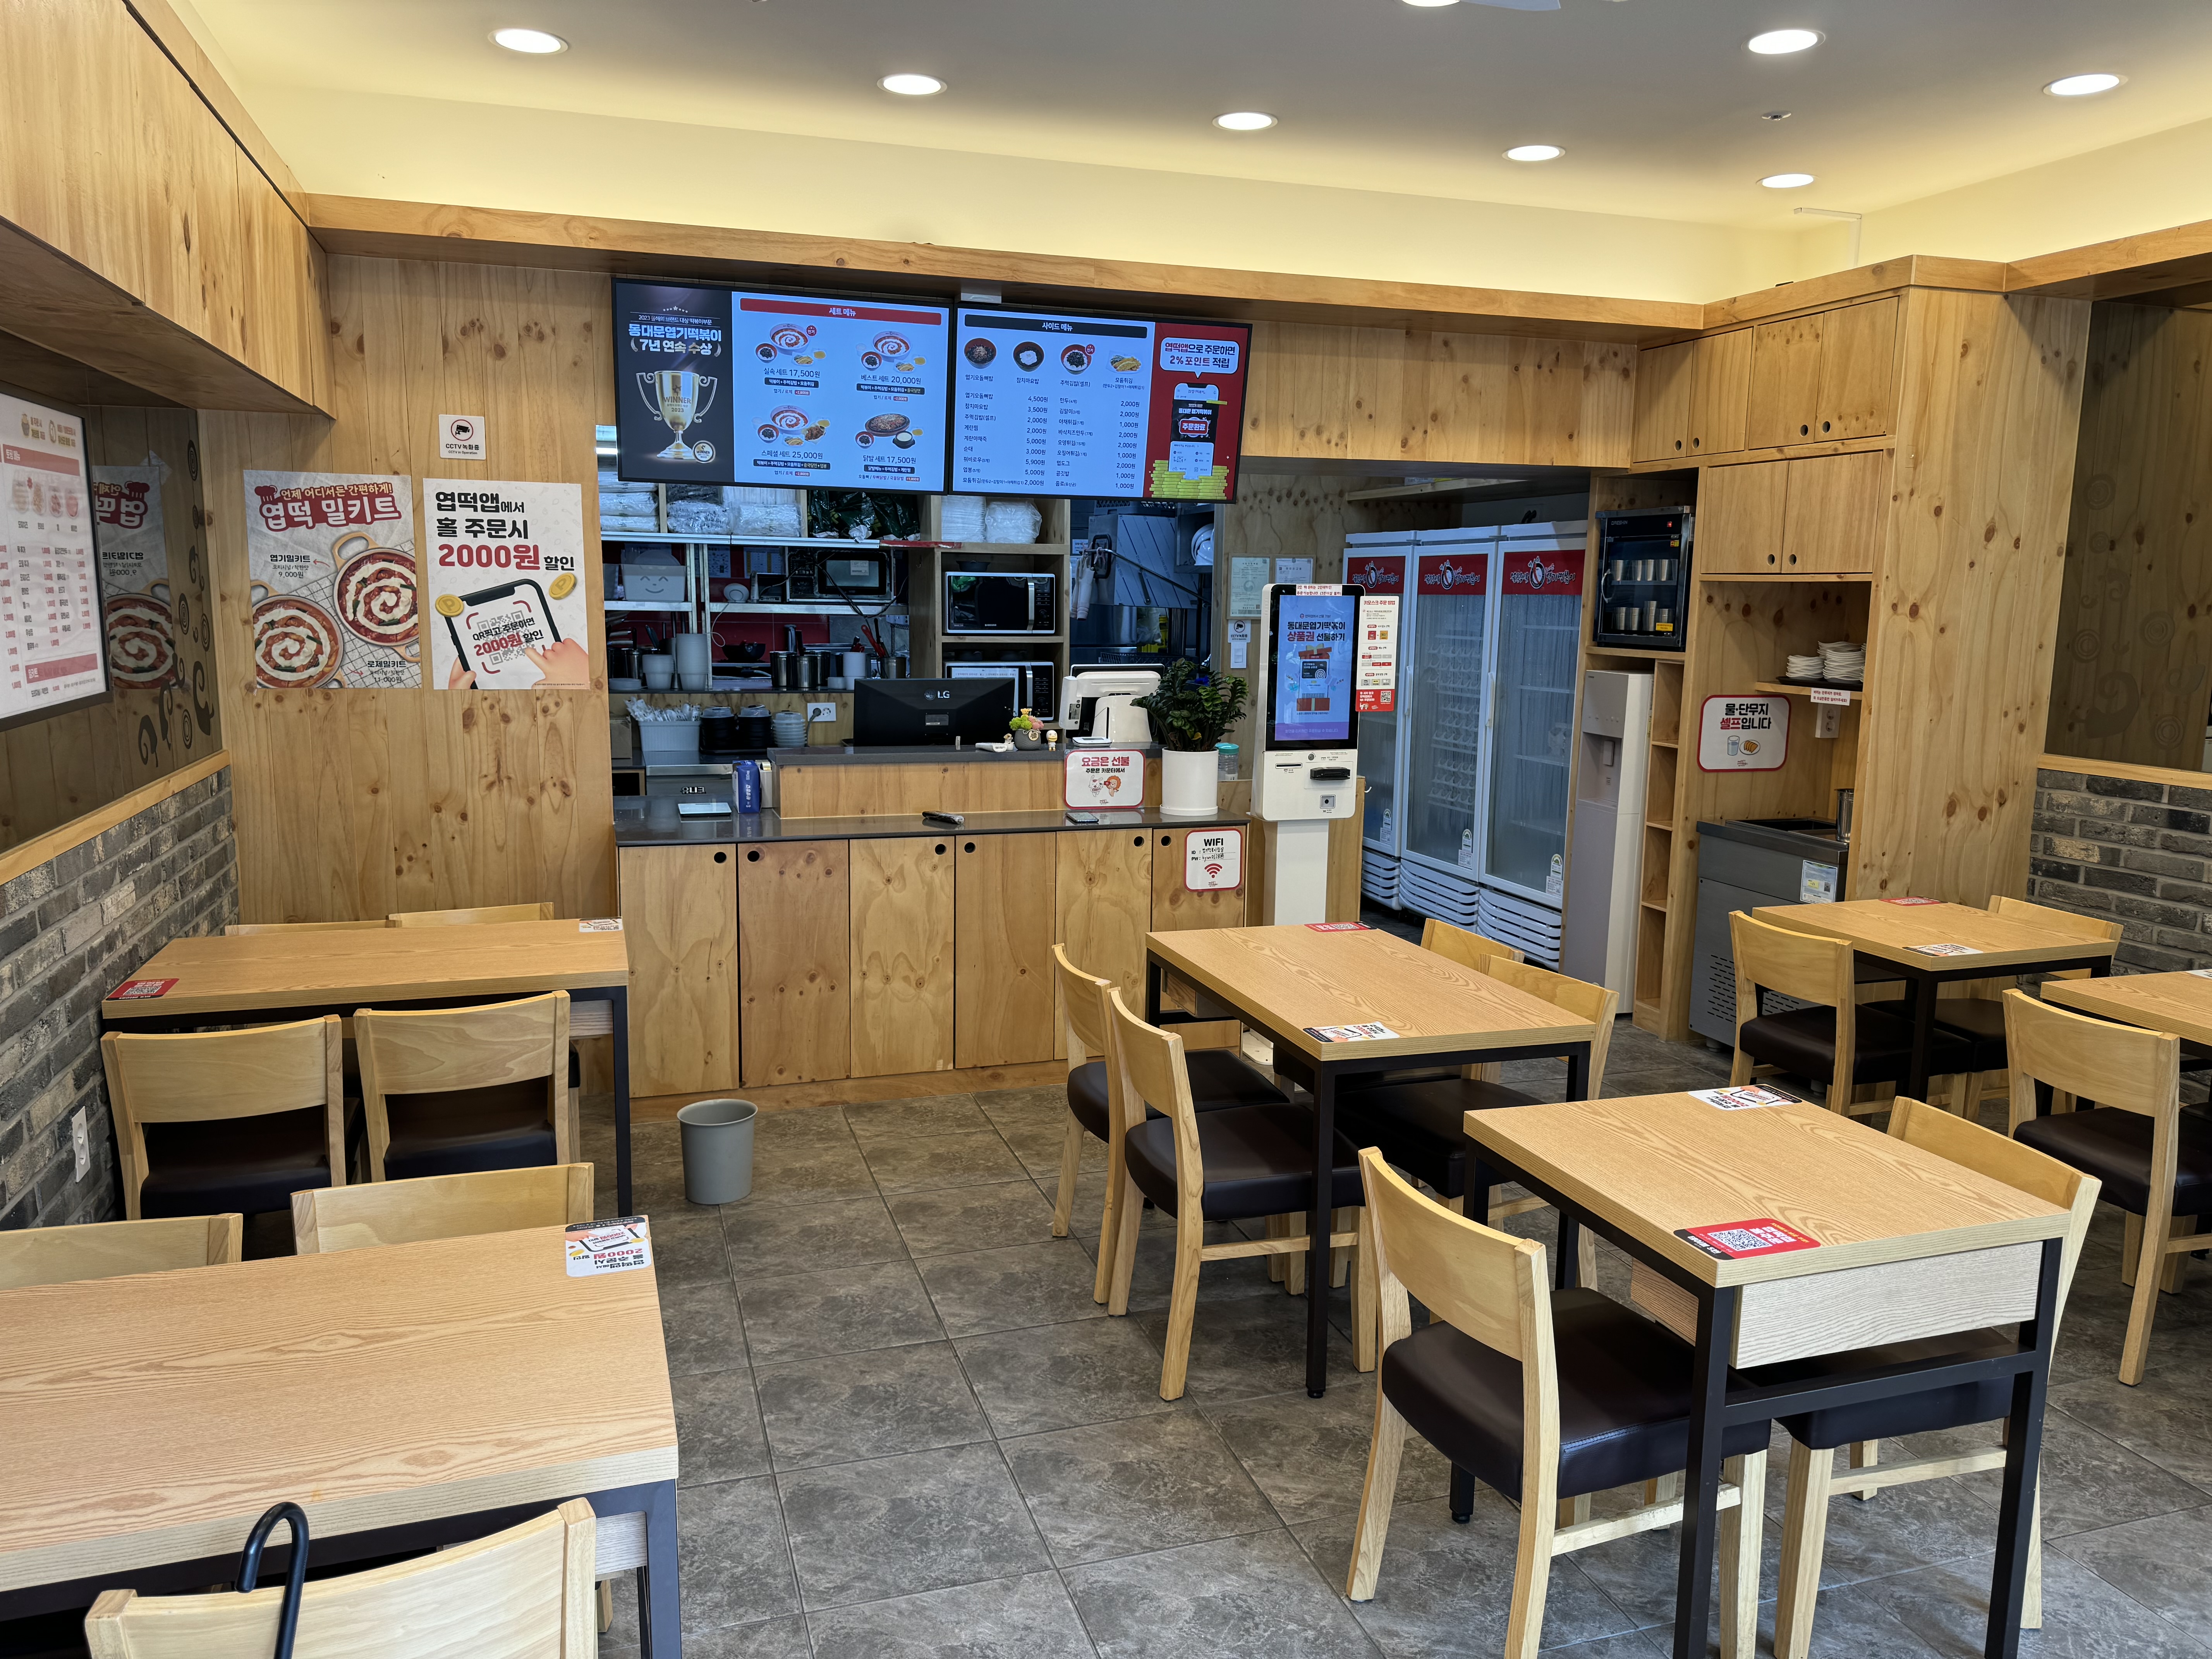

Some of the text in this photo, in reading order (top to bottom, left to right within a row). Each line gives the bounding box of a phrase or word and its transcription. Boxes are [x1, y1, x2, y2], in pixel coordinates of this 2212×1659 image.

[629, 324, 721, 341] 동대문엽기떡볶이
[1042, 322, 1073, 332] 사이드 메뉴
[640, 339, 712, 355] 7년 연속 수상
[1165, 342, 1235, 355] 엽떡앱으로 주문하면
[1170, 356, 1230, 368] 2% 포인트 적립
[789, 369, 820, 378] 17,500원
[281, 483, 393, 501] 언제 어디서든 간편하게!
[435, 492, 525, 514] 엽떡앱에서
[262, 496, 400, 529] 엽떡 밀키트
[437, 517, 529, 539] 홀 주문시
[270, 554, 311, 563] 엽기밀키트
[439, 543, 574, 571] 2000원 할인
[1546, 570, 1575, 584] 엽기떡볶이
[472, 617, 535, 642] QR찍고 주문하면
[474, 630, 544, 656] 2000원 할인
[1288, 632, 1314, 641] 상품권
[1720, 717, 1771, 730] 셀프입니다
[1082, 756, 1129, 766] 요금은 선불
[1204, 838, 1223, 846] WIFI
[594, 1249, 642, 1259] 2000원
[596, 1260, 644, 1268] 엽떡앱에서
